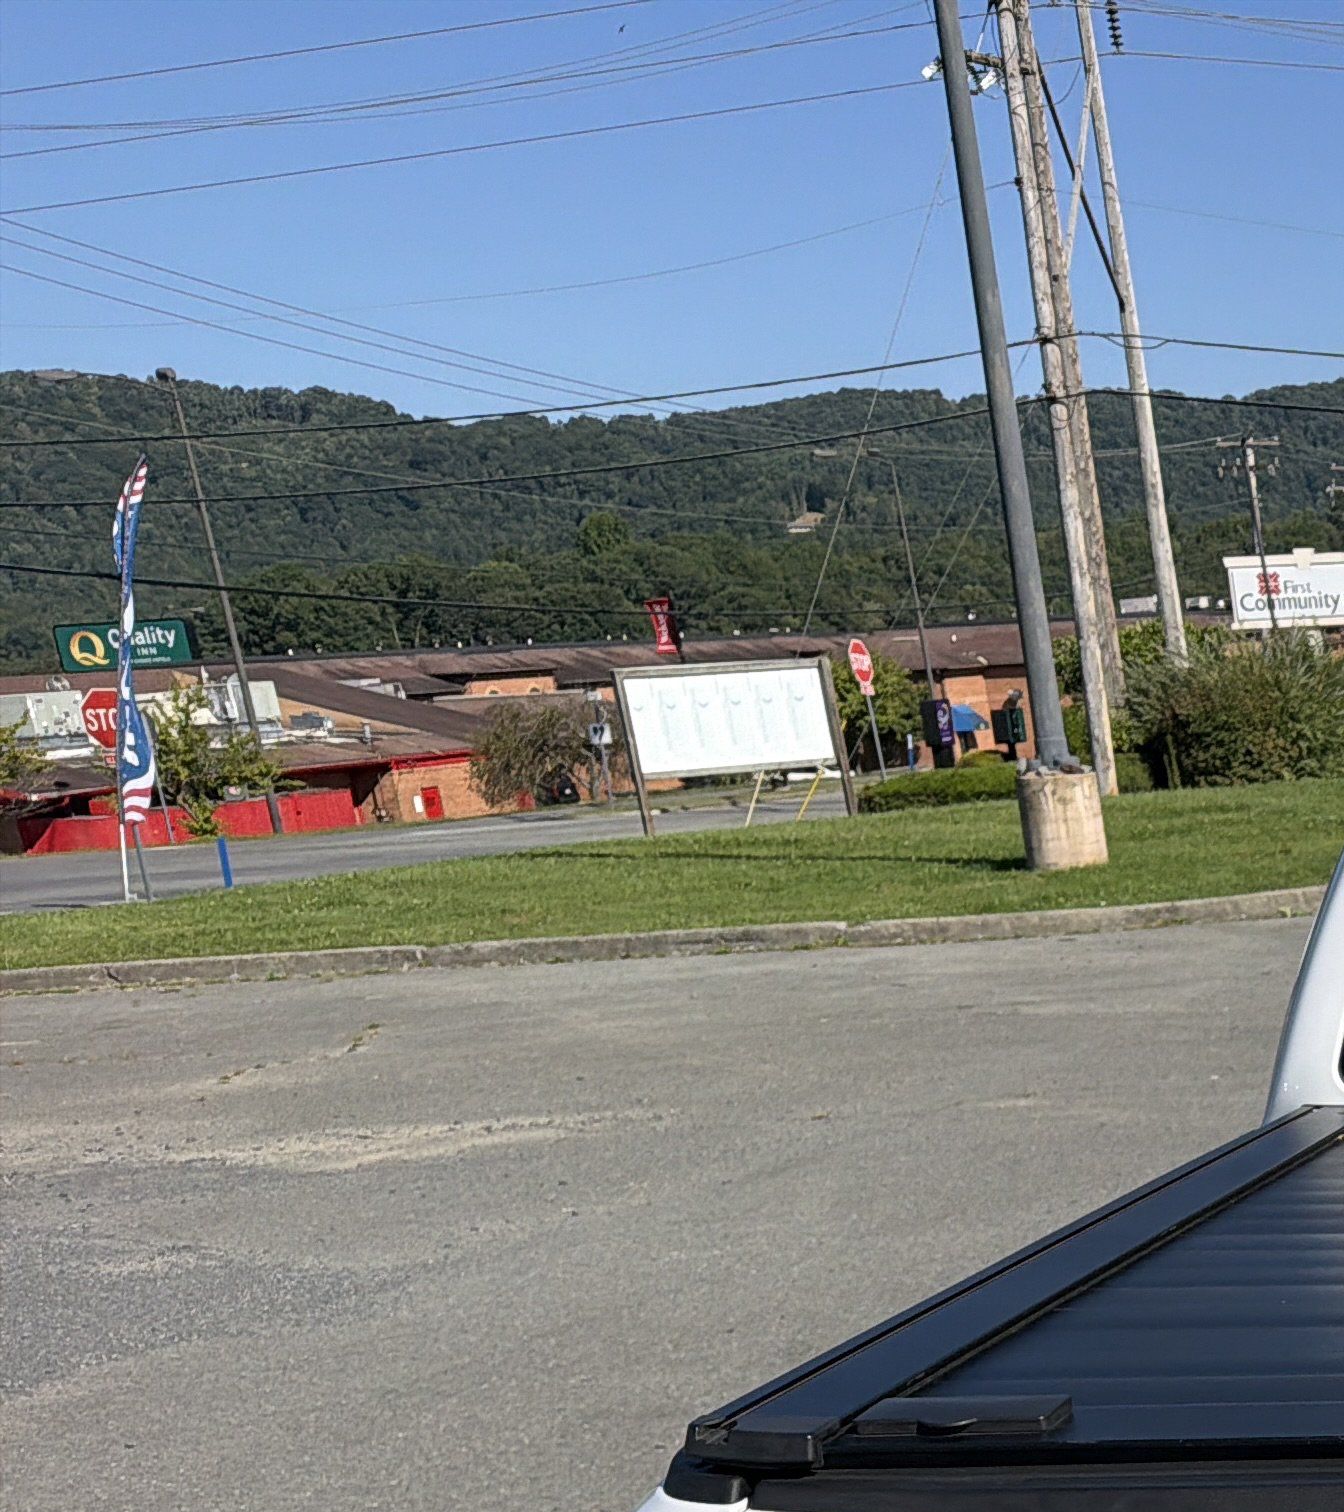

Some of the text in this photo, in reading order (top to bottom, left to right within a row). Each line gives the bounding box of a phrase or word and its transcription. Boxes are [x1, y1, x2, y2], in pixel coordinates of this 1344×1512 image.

[1283, 579, 1312, 594] First
[1240, 591, 1340, 615] Community
[107, 626, 176, 649] Qality
[136, 647, 158, 656] INN
[85, 707, 118, 732] STO
